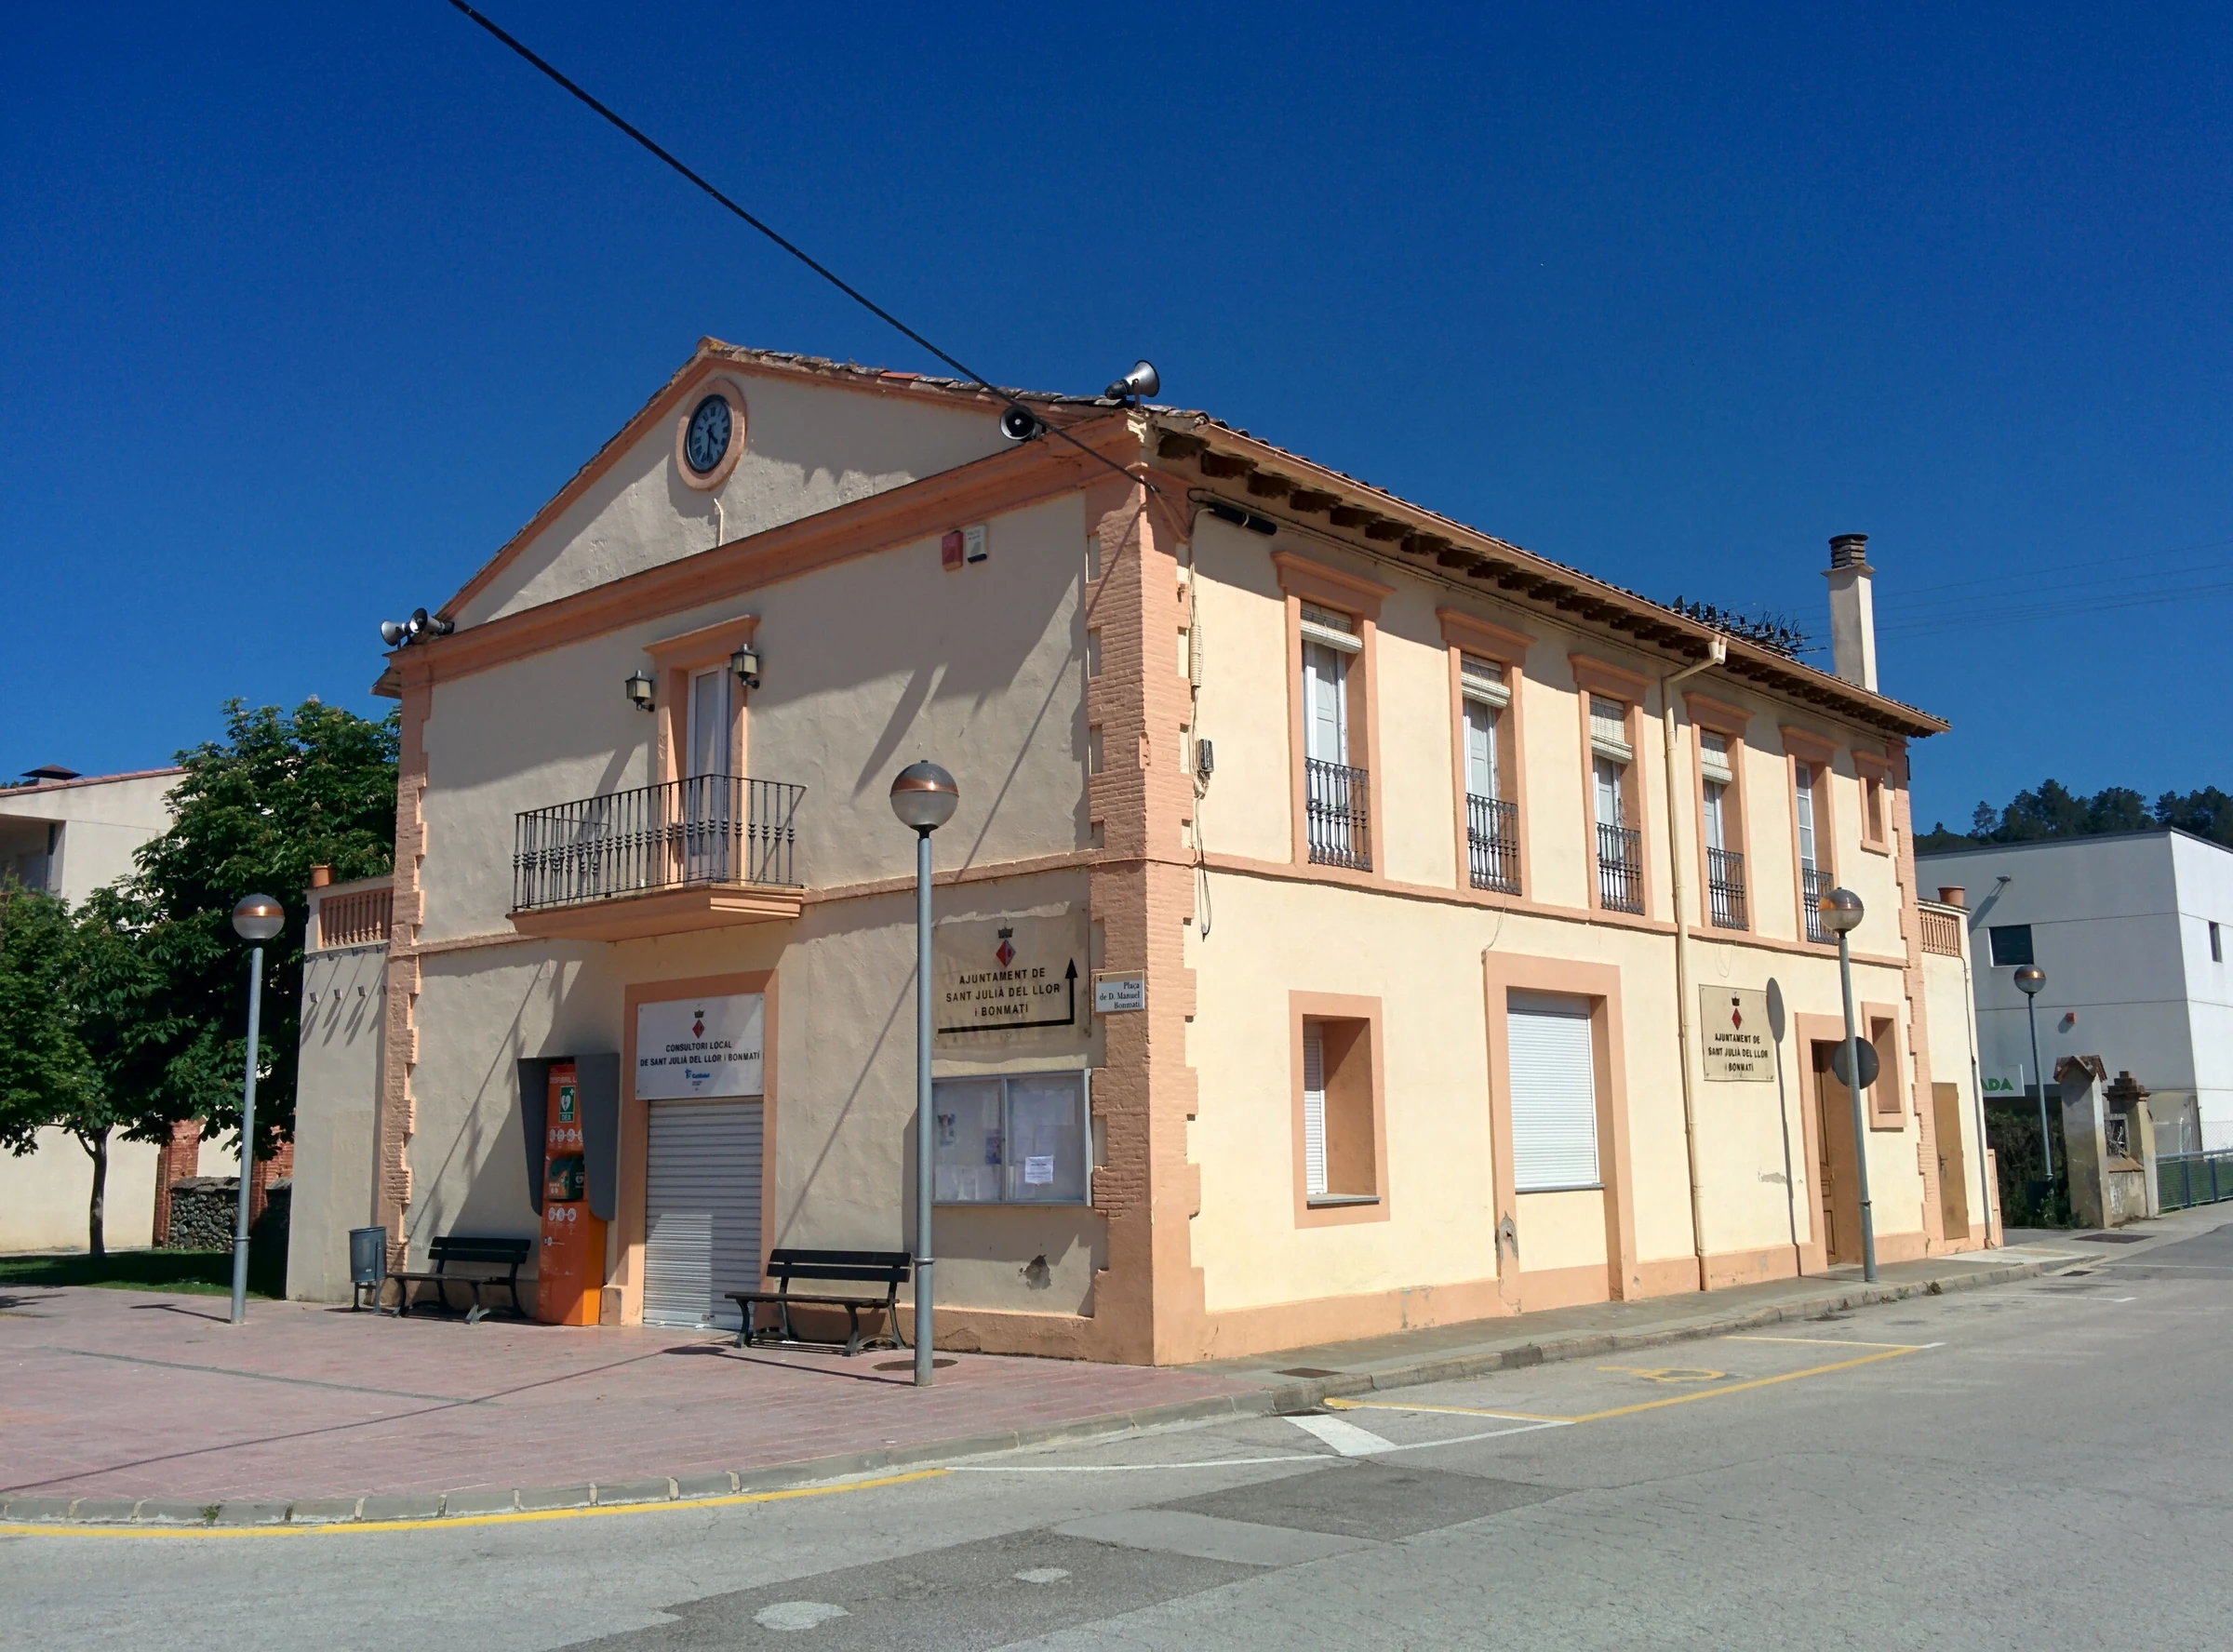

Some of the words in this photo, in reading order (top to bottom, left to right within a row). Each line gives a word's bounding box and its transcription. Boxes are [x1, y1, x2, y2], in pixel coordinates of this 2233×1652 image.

[959, 969, 1027, 985] AJUNTAMENT
[1032, 967, 1045, 978] DE
[1123, 981, 1140, 990] Plaça
[946, 991, 971, 1003] SANT
[976, 986, 1004, 1000] JULIÀ
[1009, 986, 1028, 997] DEL
[1033, 983, 1060, 995] LLOR
[1099, 993, 1107, 1001] de
[1108, 993, 1116, 1001] D.
[1116, 991, 1140, 1000] Manuel
[1715, 1033, 1751, 1044] AJUNTAMENT
[1753, 1034, 1760, 1044] DE
[665, 1042, 708, 1052] CONSULTORI
[710, 1041, 732, 1050] LOCAL
[1708, 1047, 1723, 1057] SANT
[1724, 1046, 1741, 1058] JULIÀ
[1742, 1048, 1753, 1059] DEL
[1754, 1049, 1769, 1059] LLOR
[640, 1059, 649, 1067] DE
[650, 1058, 667, 1066] SANT
[669, 1054, 688, 1065] JULIÀ
[689, 1055, 702, 1064] DEL
[704, 1054, 722, 1062] LLOR
